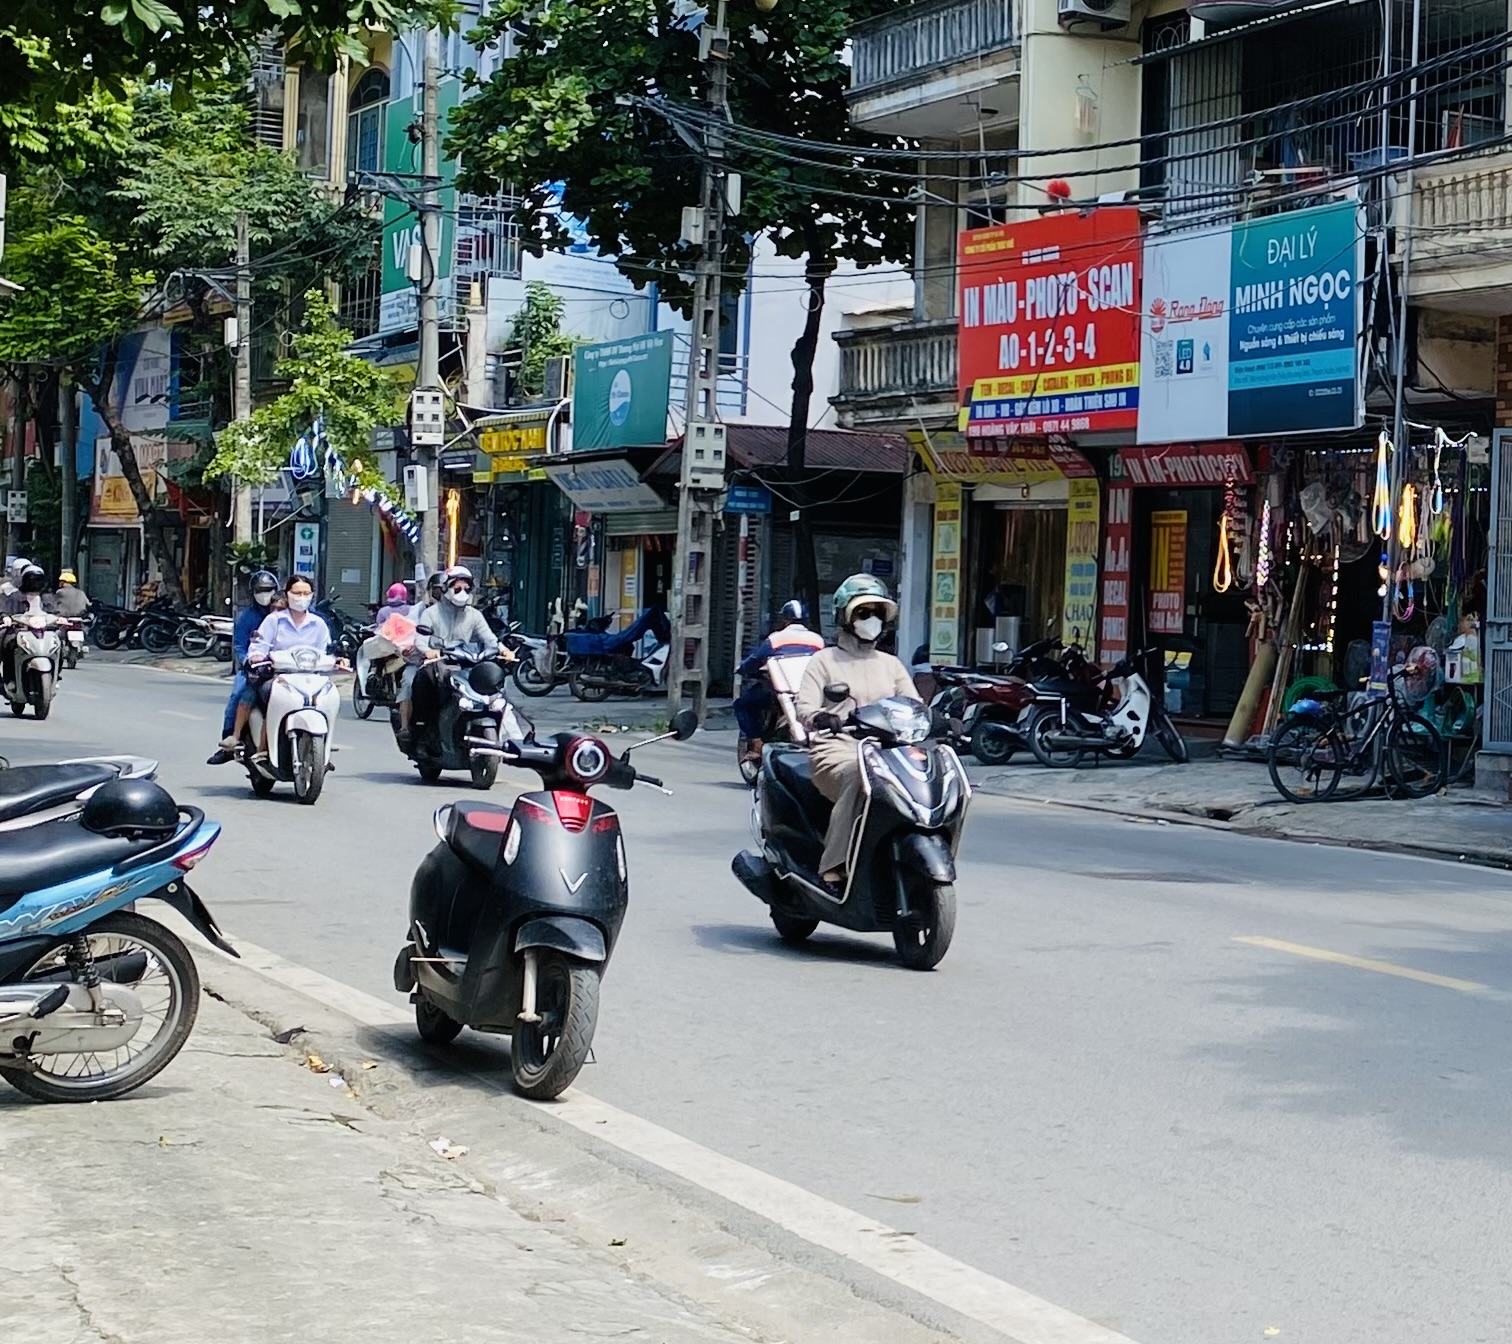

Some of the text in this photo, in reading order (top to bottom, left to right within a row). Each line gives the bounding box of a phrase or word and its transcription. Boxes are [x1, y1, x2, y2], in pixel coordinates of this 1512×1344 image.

[1268, 225, 1318, 267] ĐẠI LÝ
[964, 286, 980, 328] IN
[1235, 269, 1350, 314] MINH NGỌC
[1108, 488, 1130, 524] IN
[1153, 592, 1180, 609] PHOTO
